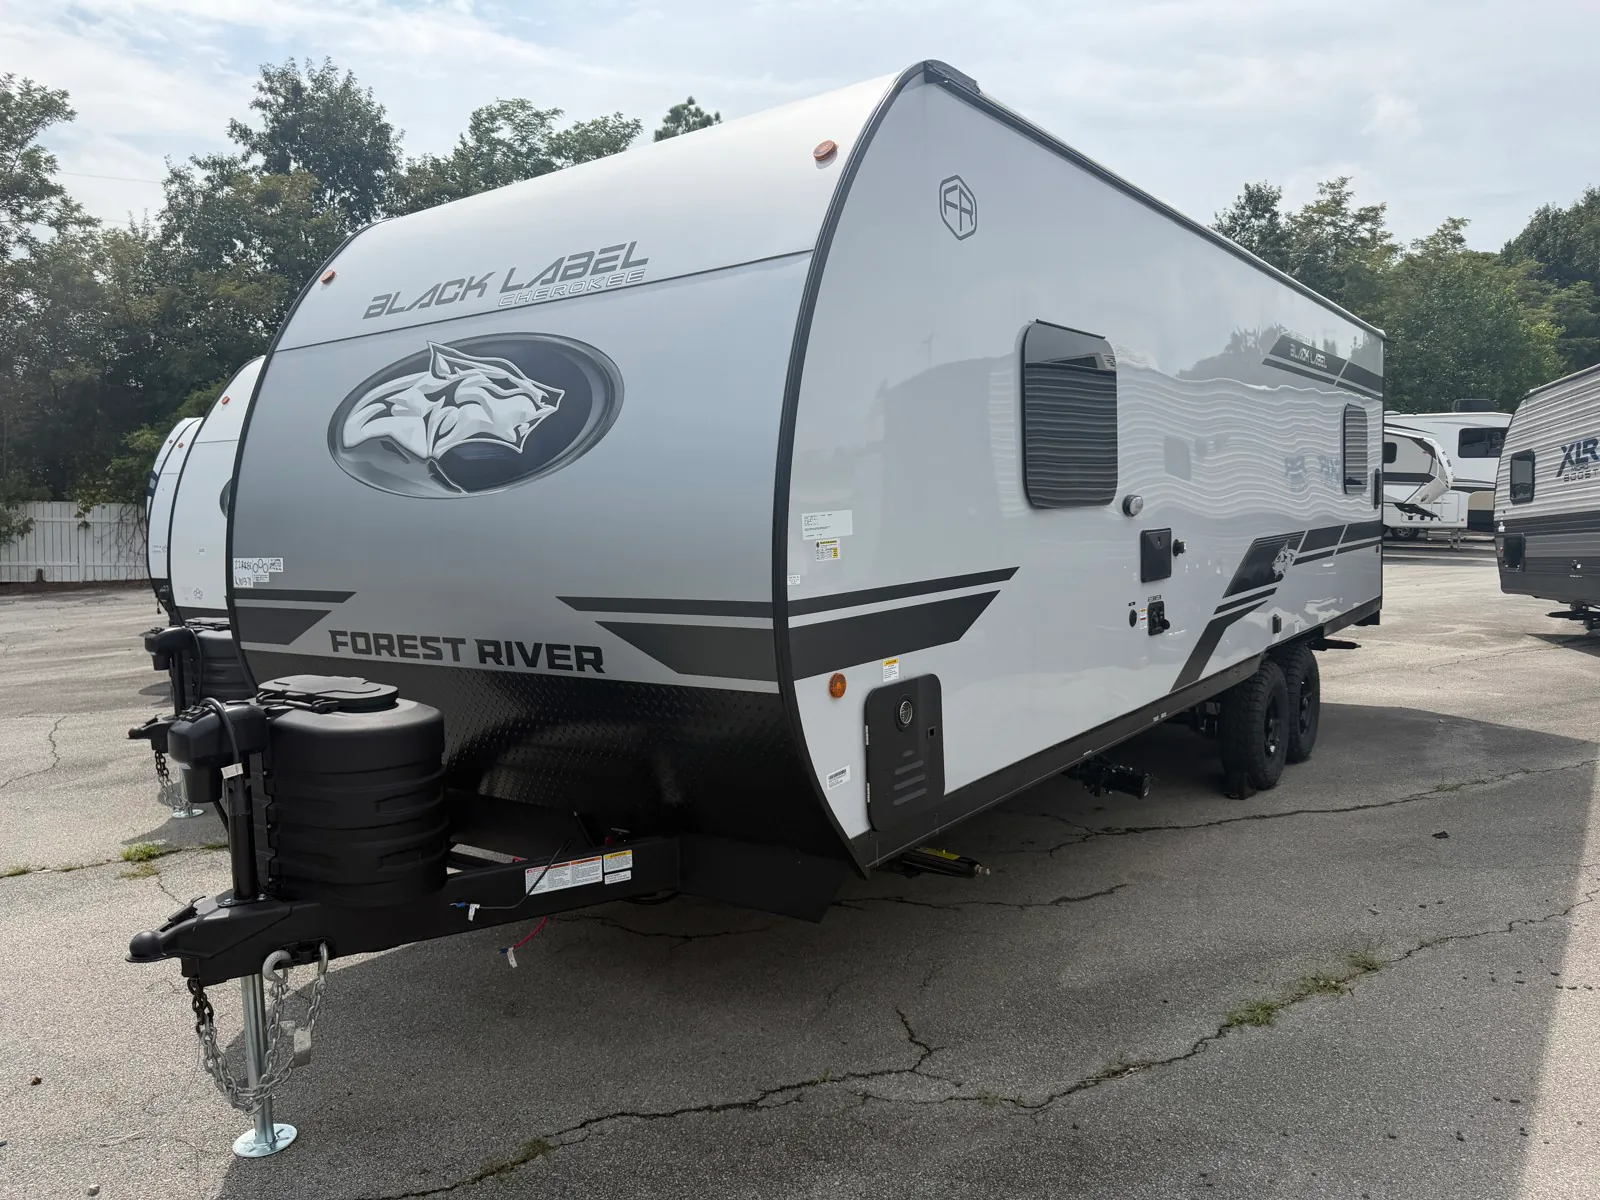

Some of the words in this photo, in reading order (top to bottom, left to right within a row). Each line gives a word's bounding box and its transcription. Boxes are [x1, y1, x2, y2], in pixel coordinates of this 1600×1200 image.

[362, 271, 496, 319] BLACK
[499, 241, 649, 293] LABEL
[498, 268, 646, 306] CHEROKEE
[1556, 438, 1600, 477] XLR
[1563, 468, 1599, 482] BOOST
[328, 630, 466, 662] FOREST
[474, 639, 605, 673] RIVER
